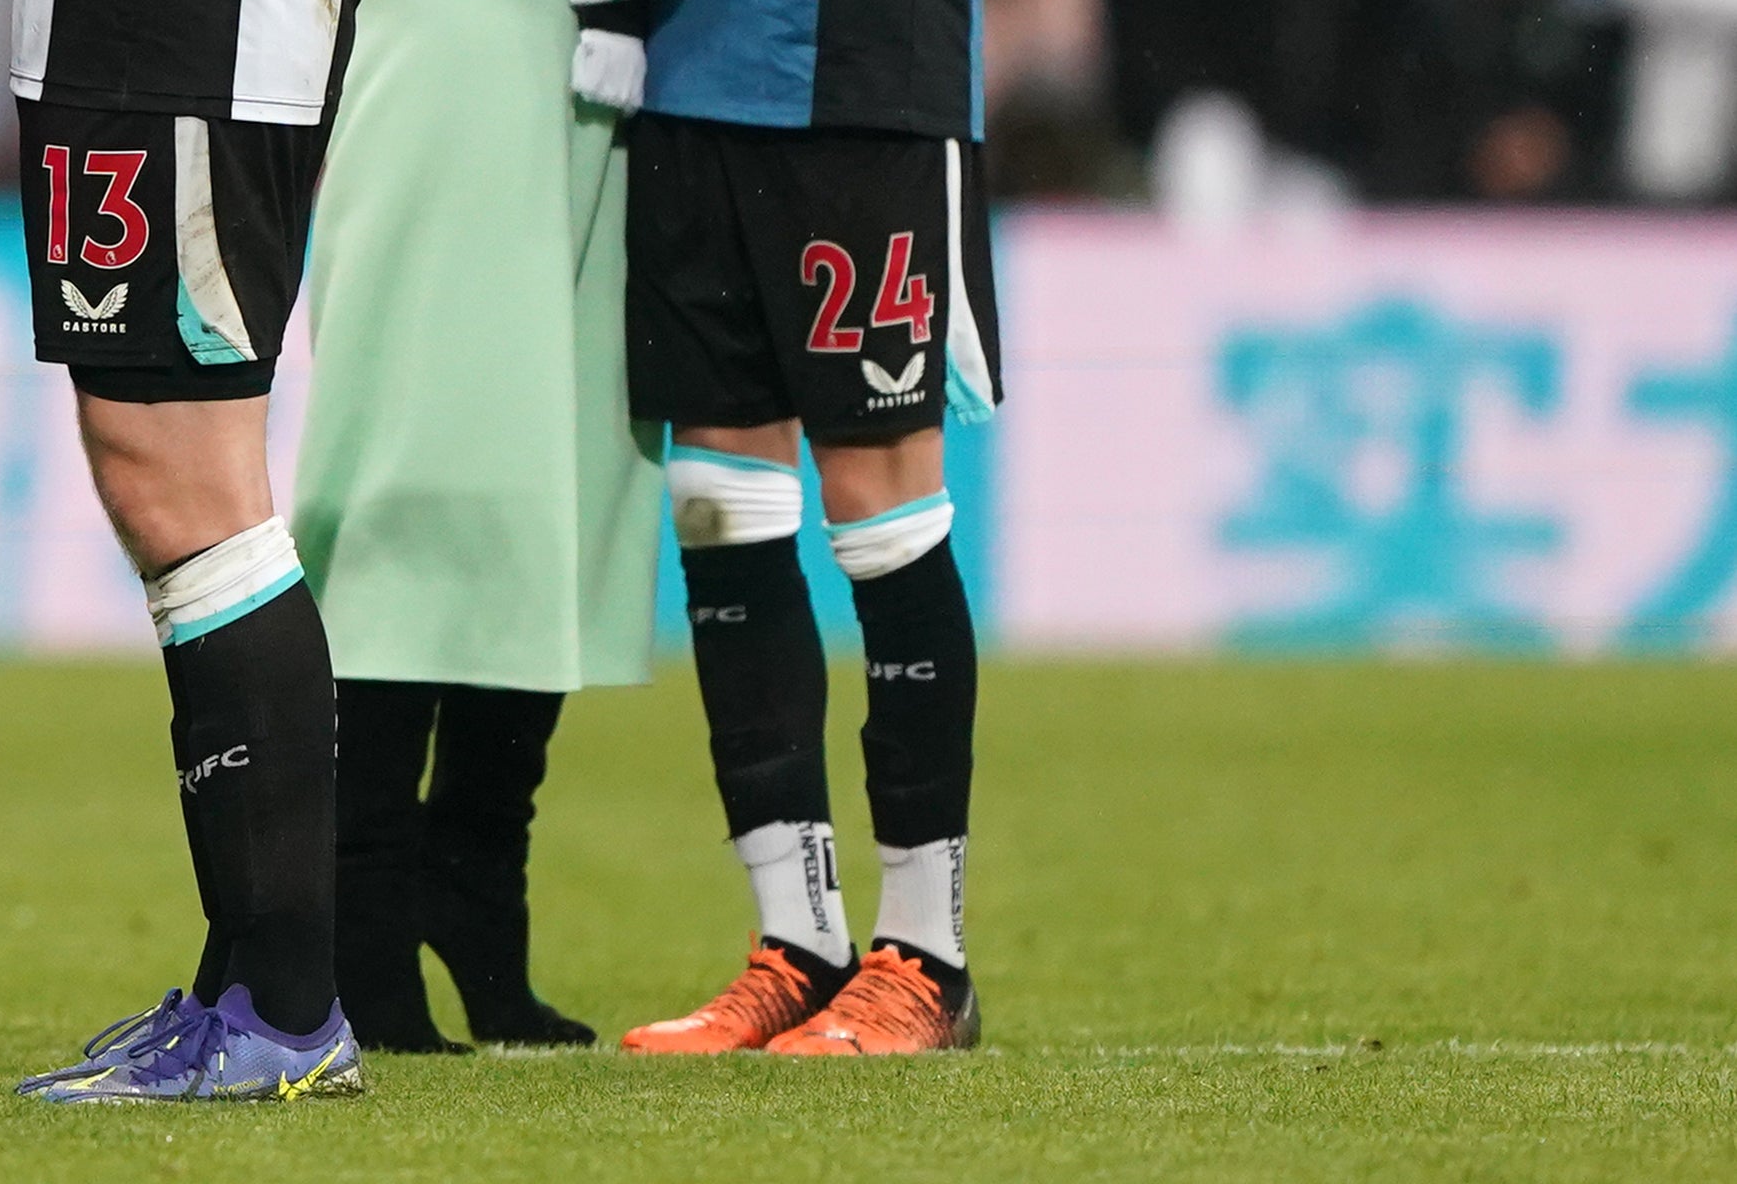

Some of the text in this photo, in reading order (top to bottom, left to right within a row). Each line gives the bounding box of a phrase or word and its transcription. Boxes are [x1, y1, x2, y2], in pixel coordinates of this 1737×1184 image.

[42, 145, 150, 270] 13
[63, 321, 127, 334] CASTORE
[800, 230, 935, 353] 24
